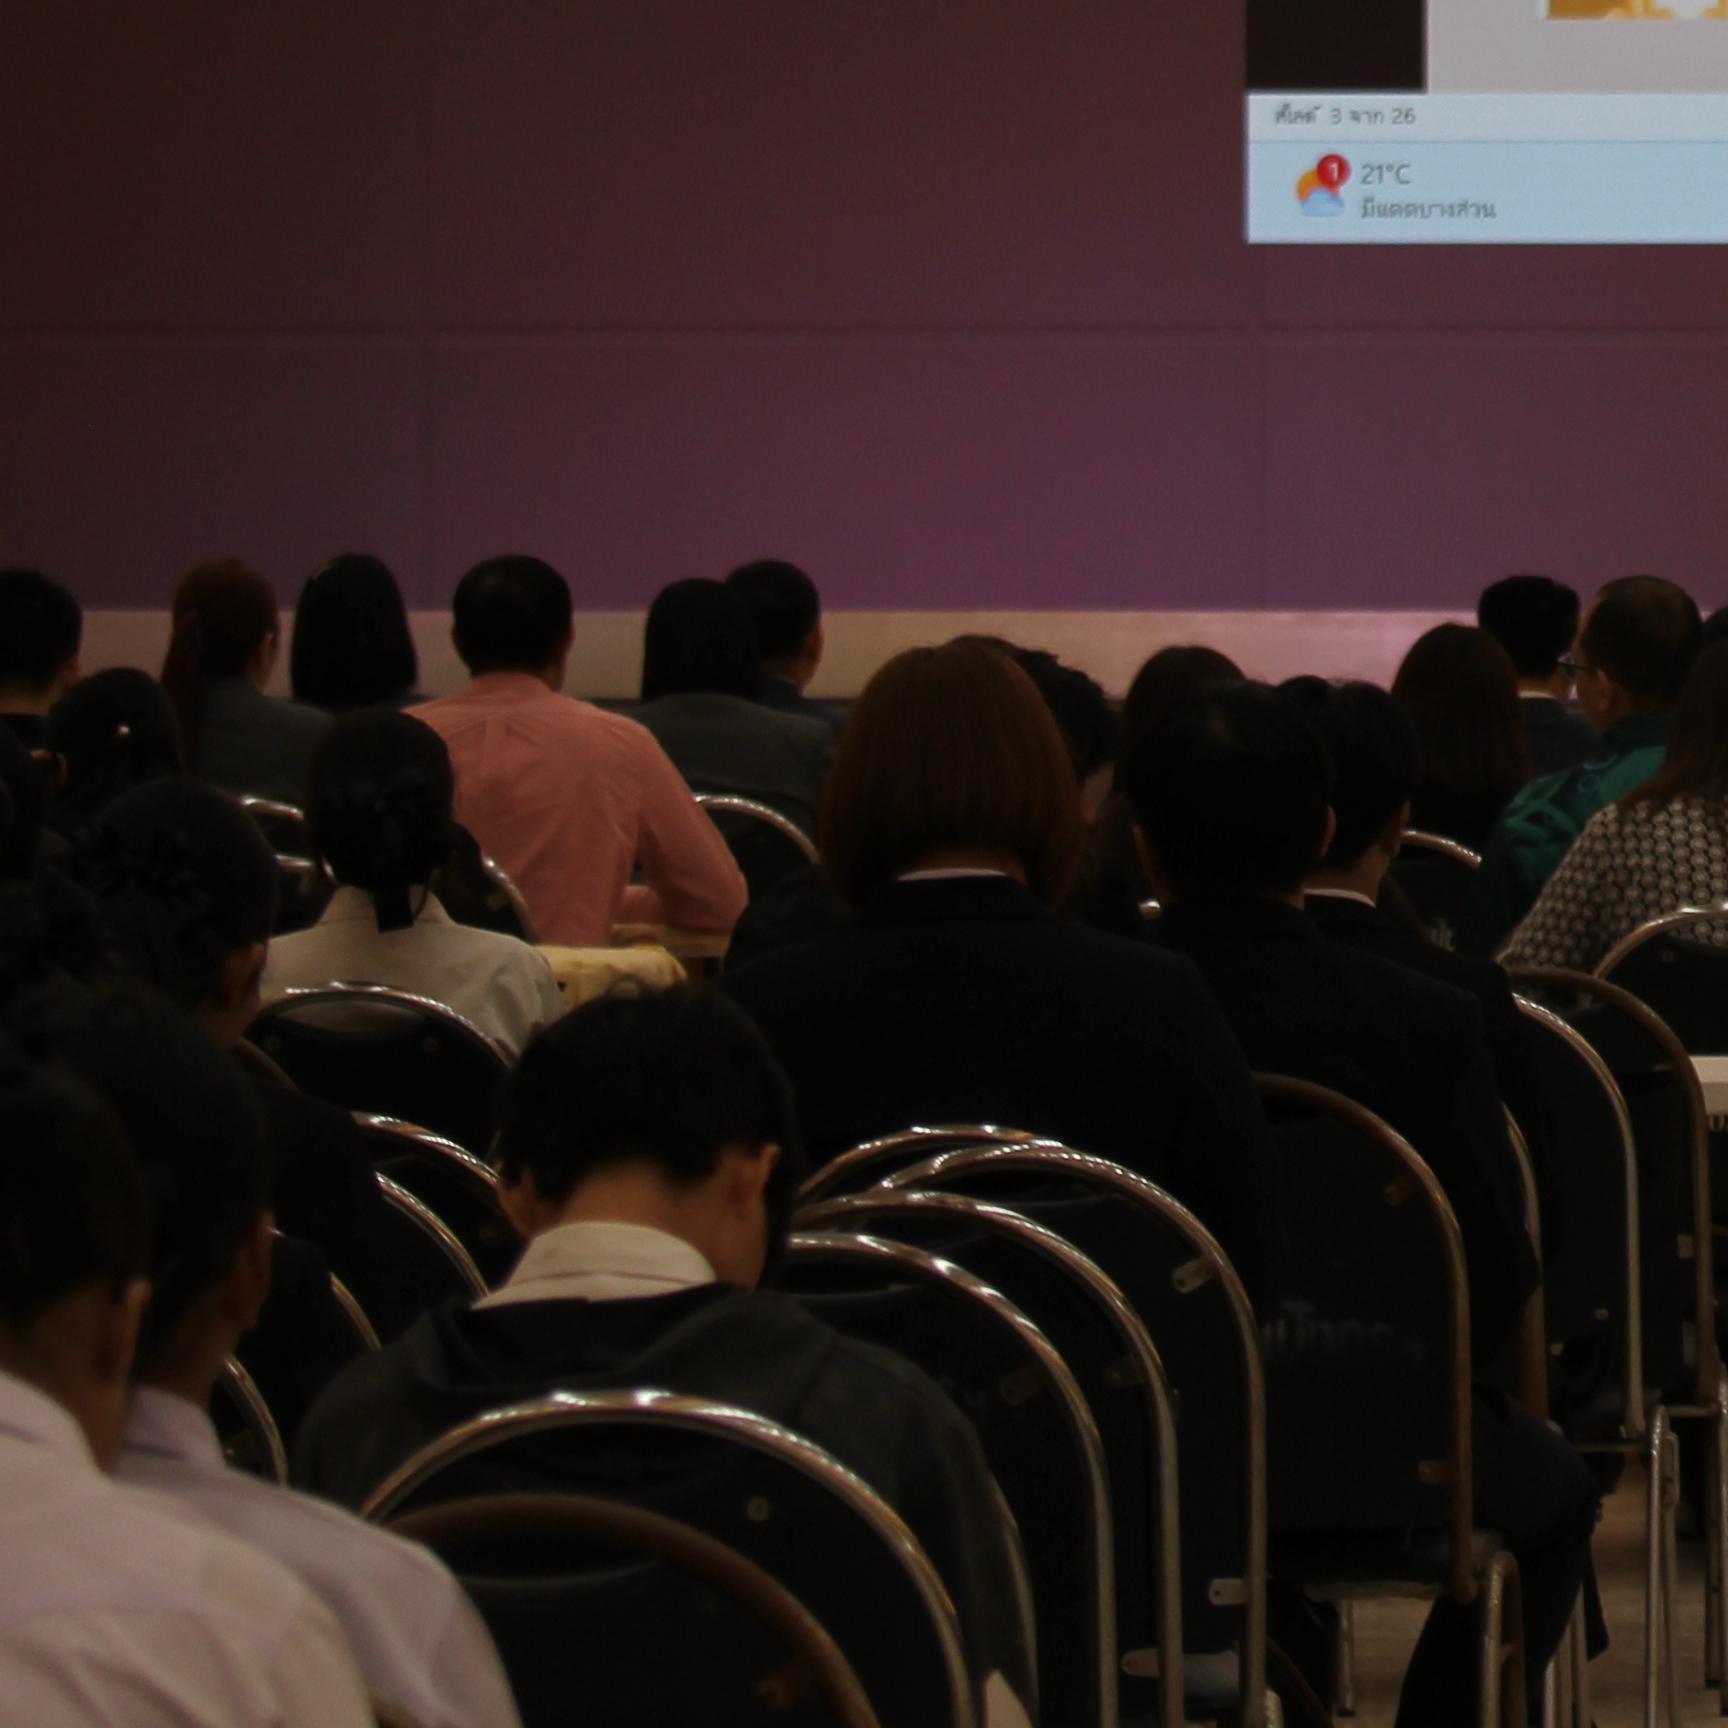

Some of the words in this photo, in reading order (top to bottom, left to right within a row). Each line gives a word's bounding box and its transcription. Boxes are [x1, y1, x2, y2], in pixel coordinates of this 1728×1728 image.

[1332, 108, 1343, 126] 3
[1392, 108, 1417, 126] 26
[1361, 164, 1412, 186] 21°C
[1361, 196, 1498, 220] มีแดดบางส่วน
